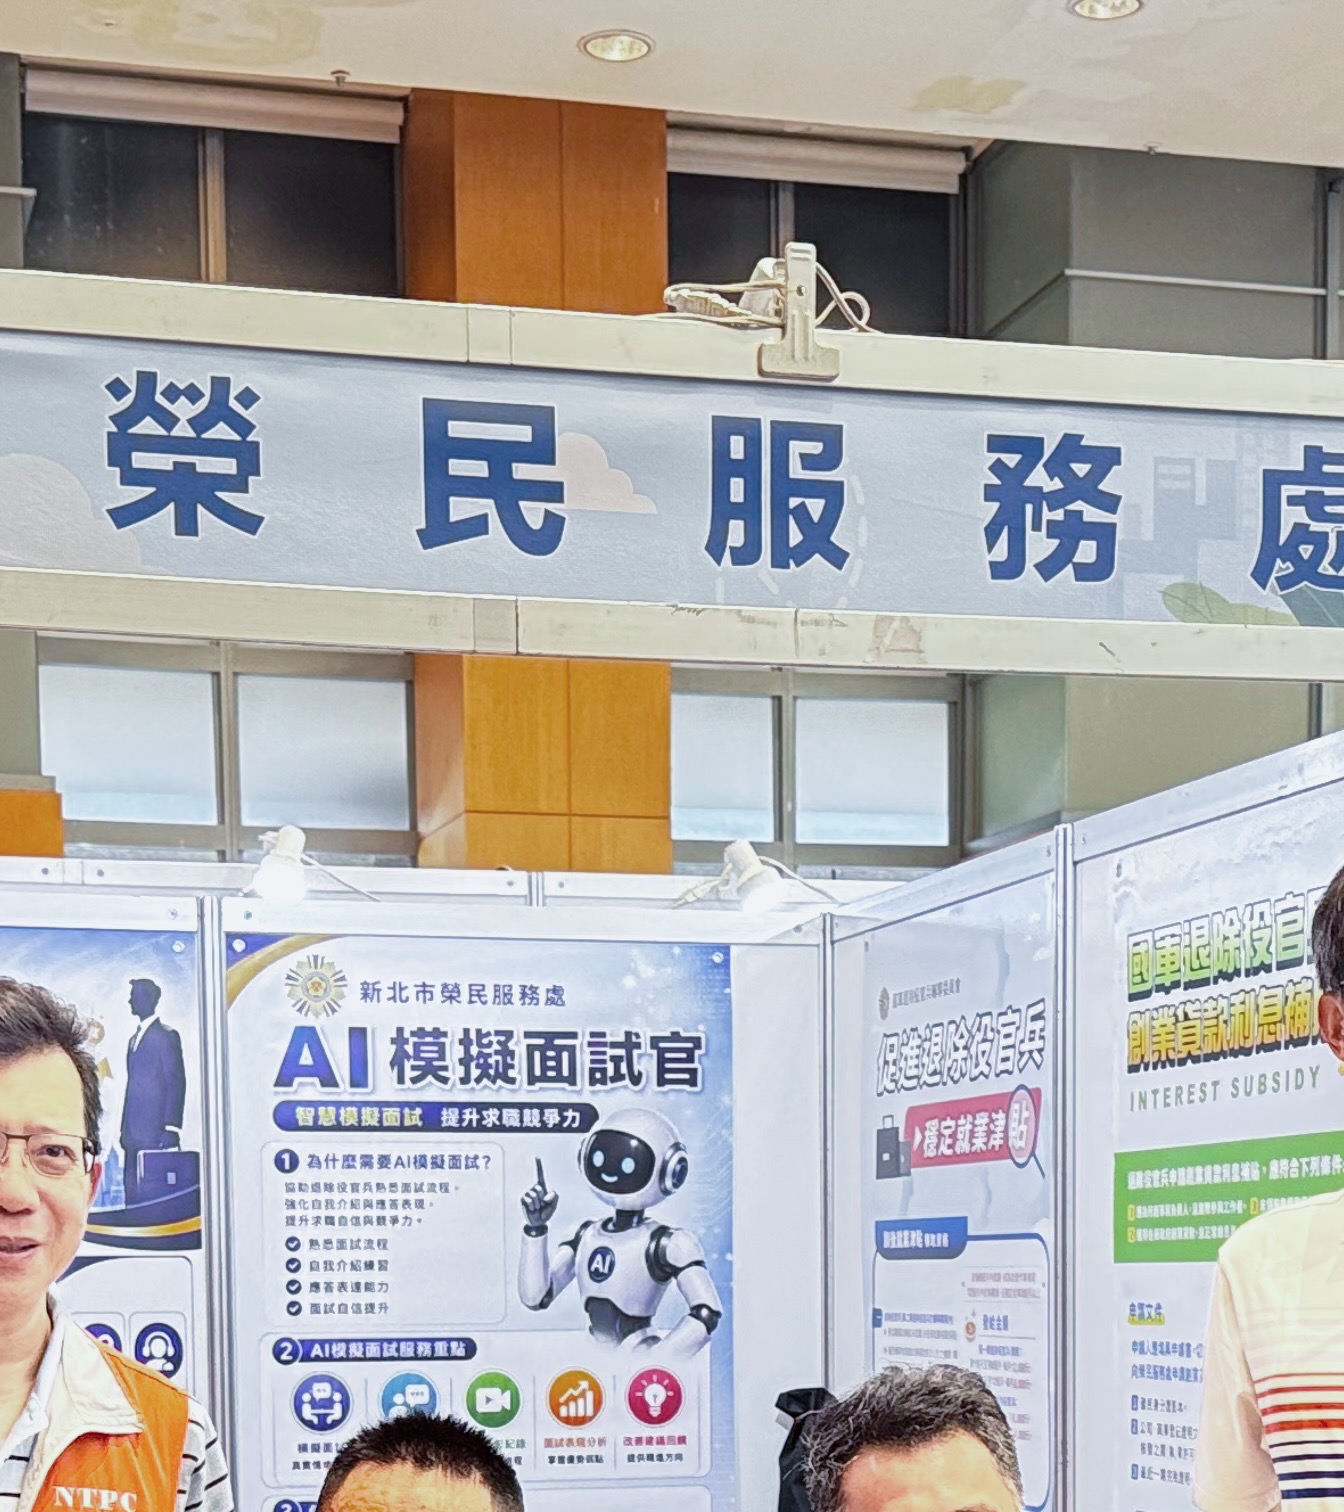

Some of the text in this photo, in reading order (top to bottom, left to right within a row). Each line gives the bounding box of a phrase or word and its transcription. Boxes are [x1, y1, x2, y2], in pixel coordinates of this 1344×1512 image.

[359, 980, 567, 1008] 新北市榮民服務處
[876, 997, 1046, 1097] 促進退除役官兵
[1127, 976, 1327, 1074] 創業貸款利息補
[273, 1025, 703, 1089] AI 模擬面試官
[1129, 1065, 1320, 1112] INTEREST SUBSIDY
[295, 1106, 582, 1130] 智慧模擬面試 提升求職競爭力
[923, 1101, 1030, 1158] 穩定就業津貼
[590, 1253, 611, 1274] AI
[279, 1342, 293, 1360] 2
